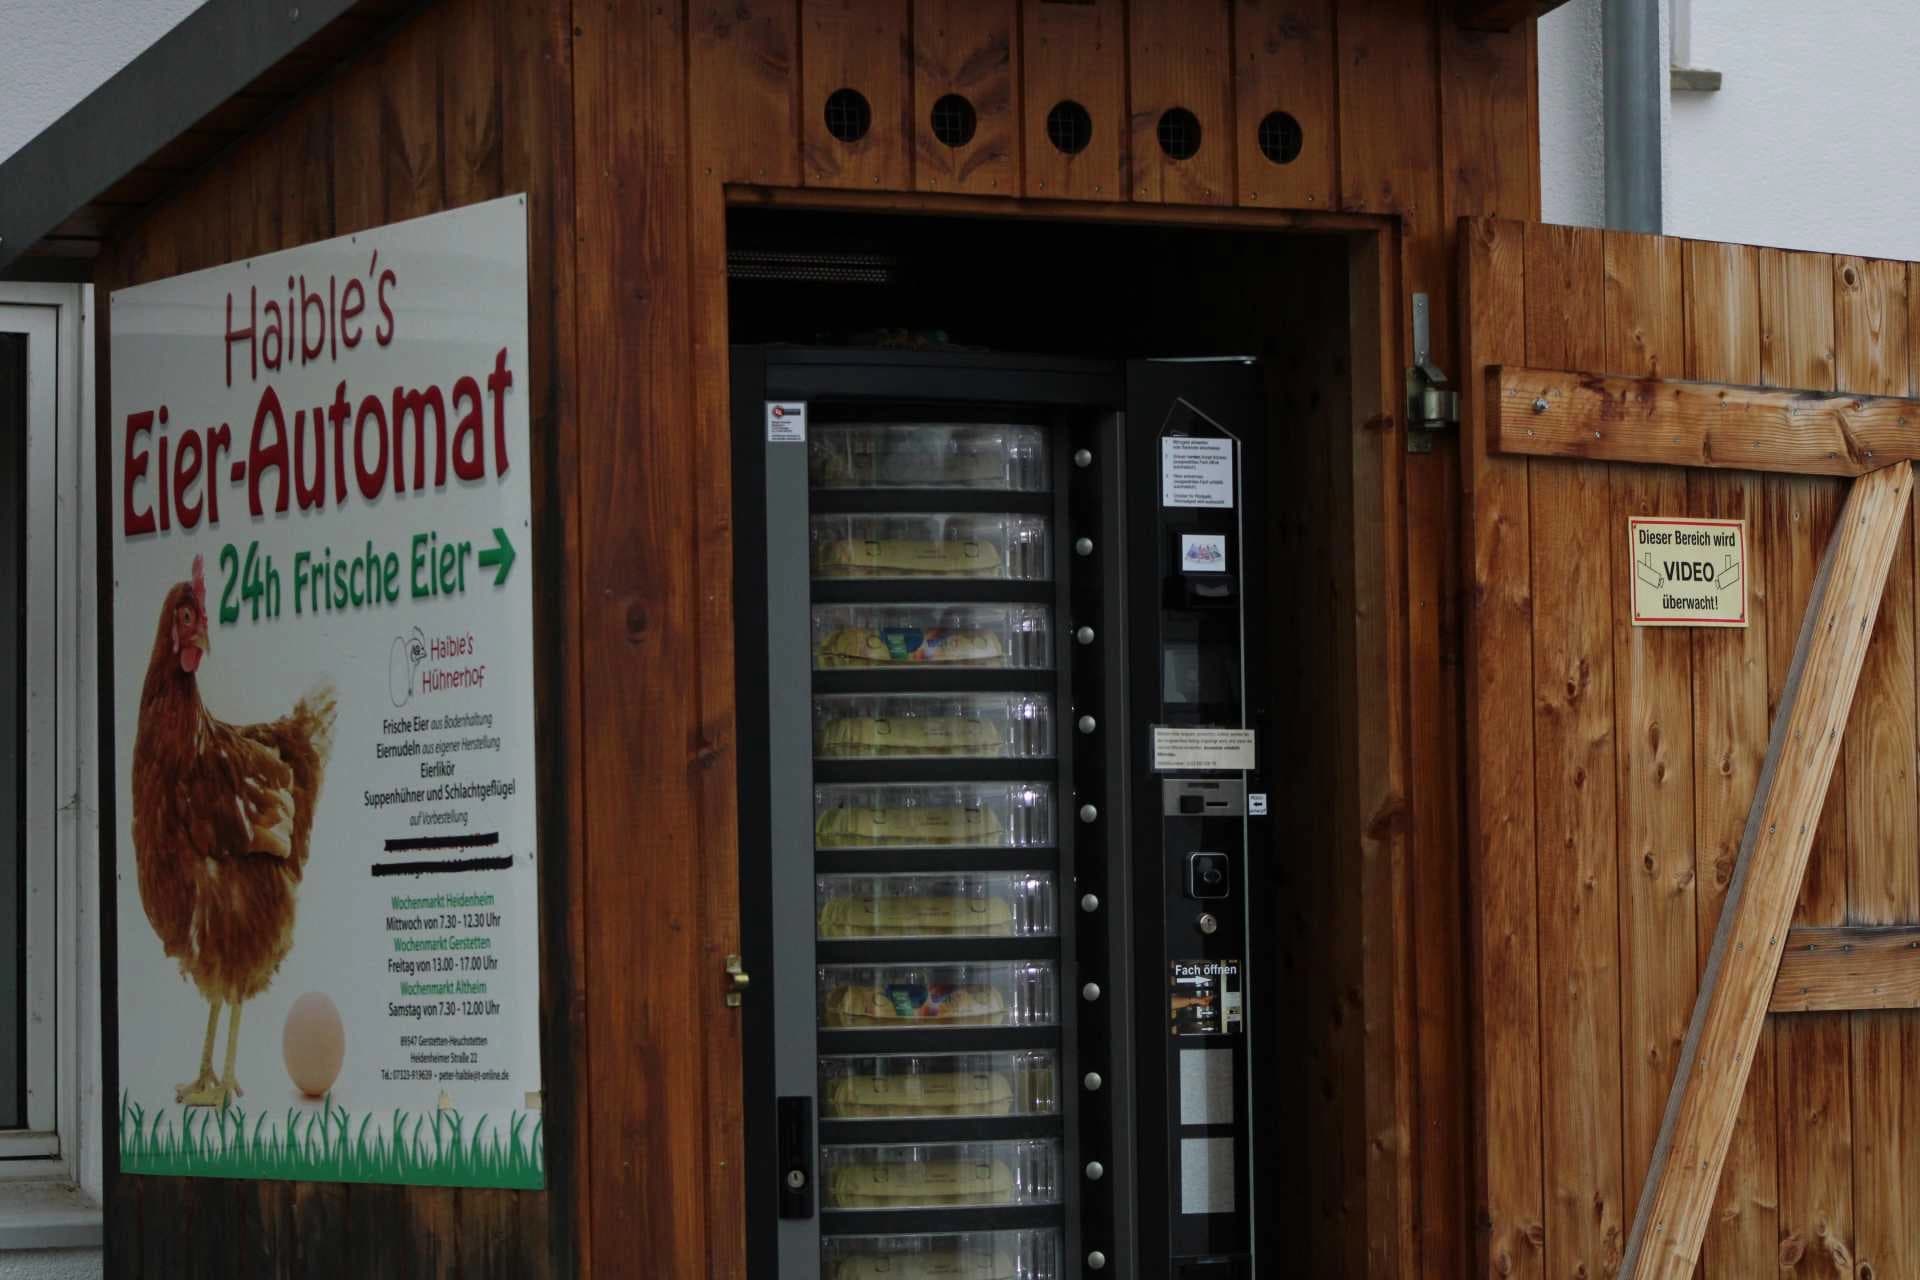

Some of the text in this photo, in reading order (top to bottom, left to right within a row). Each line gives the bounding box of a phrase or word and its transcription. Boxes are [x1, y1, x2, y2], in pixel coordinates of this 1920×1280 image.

[224, 249, 396, 387] Haible's
[124, 347, 513, 537] Eier-Automat
[1639, 530, 1736, 547] Dieser Bereich wird
[219, 531, 472, 625] 24h Frische Eier
[1664, 561, 1714, 582] VIDEO
[1663, 595, 1718, 610] überwacht!
[430, 632, 473, 661] Haible's
[422, 665, 485, 694] Hühnerhof
[383, 712, 493, 735] Frische Eier aus Bodenhaltung
[376, 735, 500, 758] Eiernudeln aus eigener Herstellung
[420, 761, 455, 778] Eierlikör
[364, 778, 516, 808] Suppenhühner und Schlachtgeflügel
[409, 809, 468, 826] auf Vorbestellung
[391, 890, 494, 910] Wochenmarkt Heidenheim
[386, 914, 422, 931] Mittwoch
[423, 917, 438, 930] von
[440, 914, 457, 929] 7.30
[463, 913, 484, 928] 12.30
[486, 912, 501, 927] Uhr
[393, 935, 491, 952] Wochenmarkt Gerstetten
[388, 958, 415, 976] Freitag
[415, 959, 431, 972] von
[432, 957, 454, 971] 13.00
[460, 956, 482, 971] 17.00
[483, 955, 498, 970] Uhr
[1175, 964, 1237, 975] Fach öffnen
[401, 980, 487, 996] Wochenmarkt Altheim
[388, 1001, 422, 1020] Samstag
[423, 1004, 438, 1017] von
[439, 1002, 456, 1016] 7.30
[463, 1001, 484, 1016] 12.00
[485, 1000, 500, 1016] Uhr
